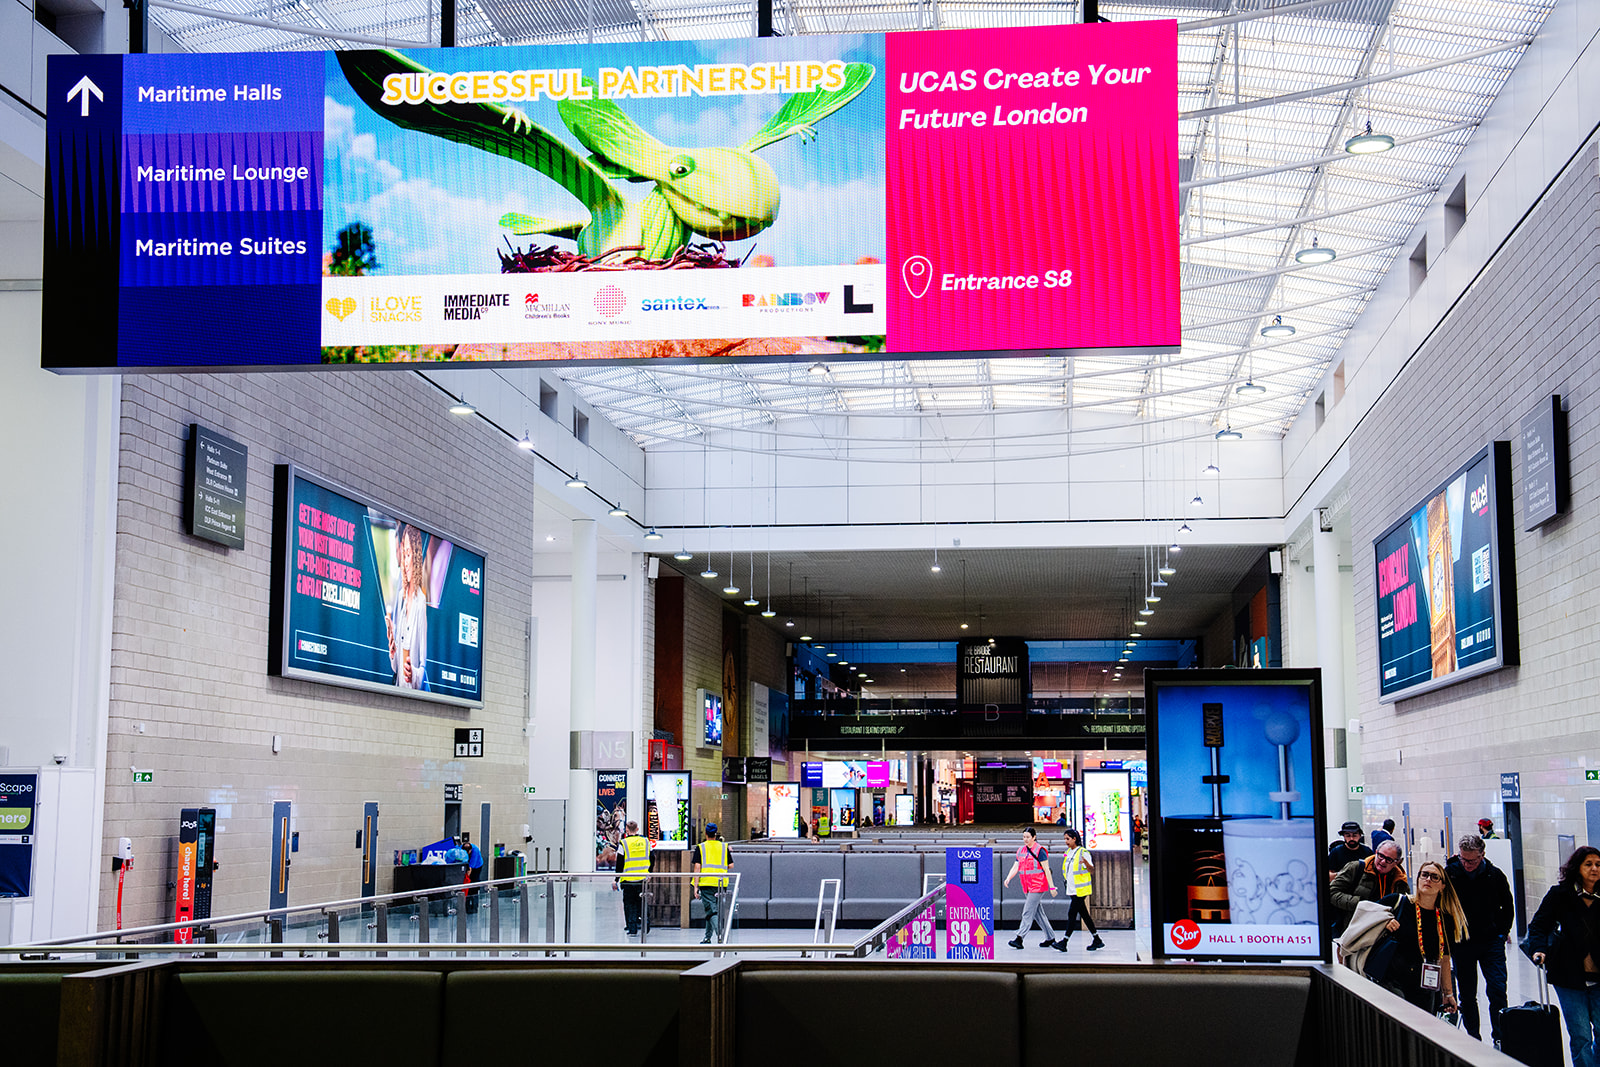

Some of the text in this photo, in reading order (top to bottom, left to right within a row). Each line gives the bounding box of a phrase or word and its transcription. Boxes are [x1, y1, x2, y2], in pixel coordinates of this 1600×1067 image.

[384, 61, 846, 103] SUCCESSFUL PARTNERSHIPS
[900, 64, 1151, 93] UCAS Create Your
[138, 84, 282, 102] Maritime Halls
[899, 102, 1088, 130] Future London
[137, 164, 309, 183] Maritime Lounge
[135, 237, 307, 256] Maritime Suites
[941, 269, 1073, 291] Entrance S8
[444, 294, 510, 307] IMMEDIATE
[525, 303, 571, 312] MACMILLAN
[641, 295, 707, 312] santex
[742, 292, 831, 308] RAINBOW
[370, 311, 423, 323] SNACKS
[299, 503, 355, 542] GET THE MOST OUT OF
[298, 525, 313, 550] YOUR
[342, 543, 354, 564] OUR
[297, 549, 329, 579] UP-TO-DATE
[314, 579, 322, 600] AT
[338, 586, 360, 611] LONDON
[1393, 582, 1418, 633] LONDON
[964, 656, 1019, 674] RESTAURANT
[984, 703, 1000, 721] B
[599, 740, 626, 760] N5
[599, 774, 626, 782] CONNECT
[599, 788, 616, 796] LIVES
[183, 846, 192, 876] charge
[957, 850, 982, 859] UCAS
[949, 906, 991, 920] ENTRANCE
[950, 920, 971, 945] S8
[1173, 925, 1199, 945] Stor
[1209, 934, 1312, 944] HALL 1 BOOTH A151
[950, 946, 991, 960] THIS WAY
